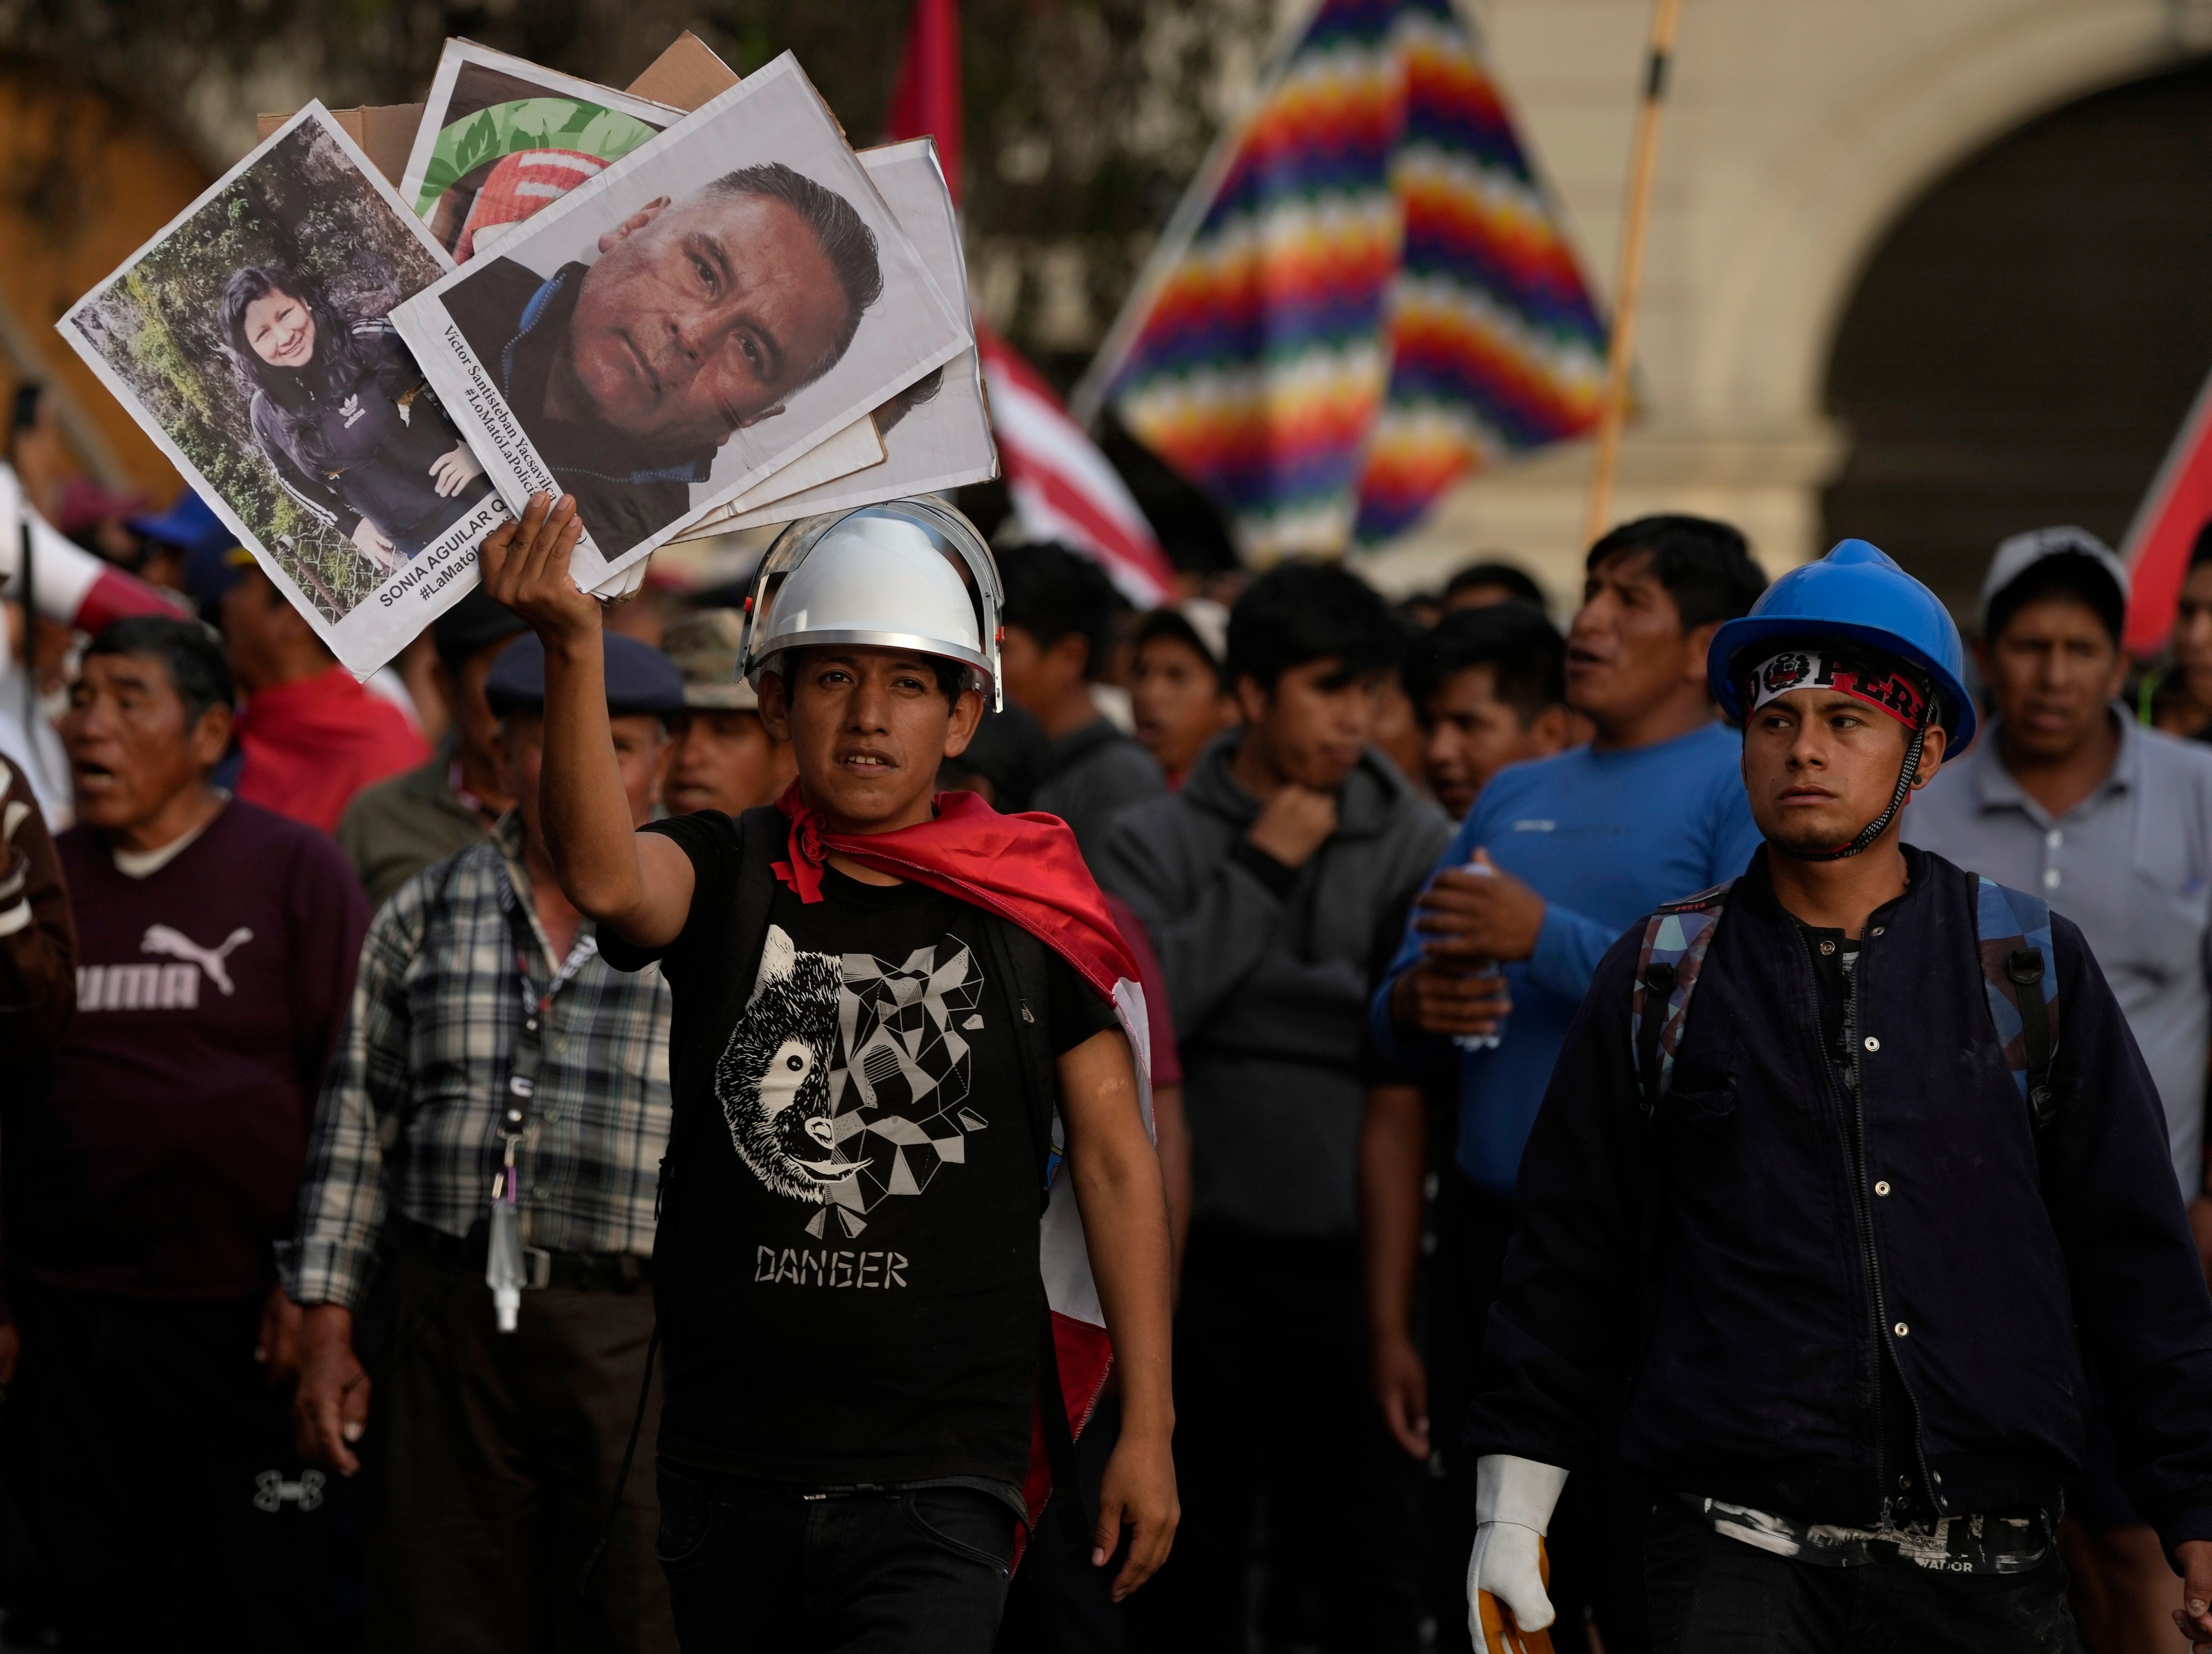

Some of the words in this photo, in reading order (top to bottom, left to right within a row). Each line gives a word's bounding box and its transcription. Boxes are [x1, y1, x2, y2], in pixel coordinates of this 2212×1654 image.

[444, 324, 472, 365] Víctor
[468, 365, 517, 439] Santisteban
[515, 437, 557, 503] Yacsavilca
[380, 566, 429, 607] SONIA
[427, 510, 493, 570] AGUILAR
[491, 499, 508, 513] Q
[75, 962, 200, 1013] UMA
[754, 1245, 909, 1289] DANGER
